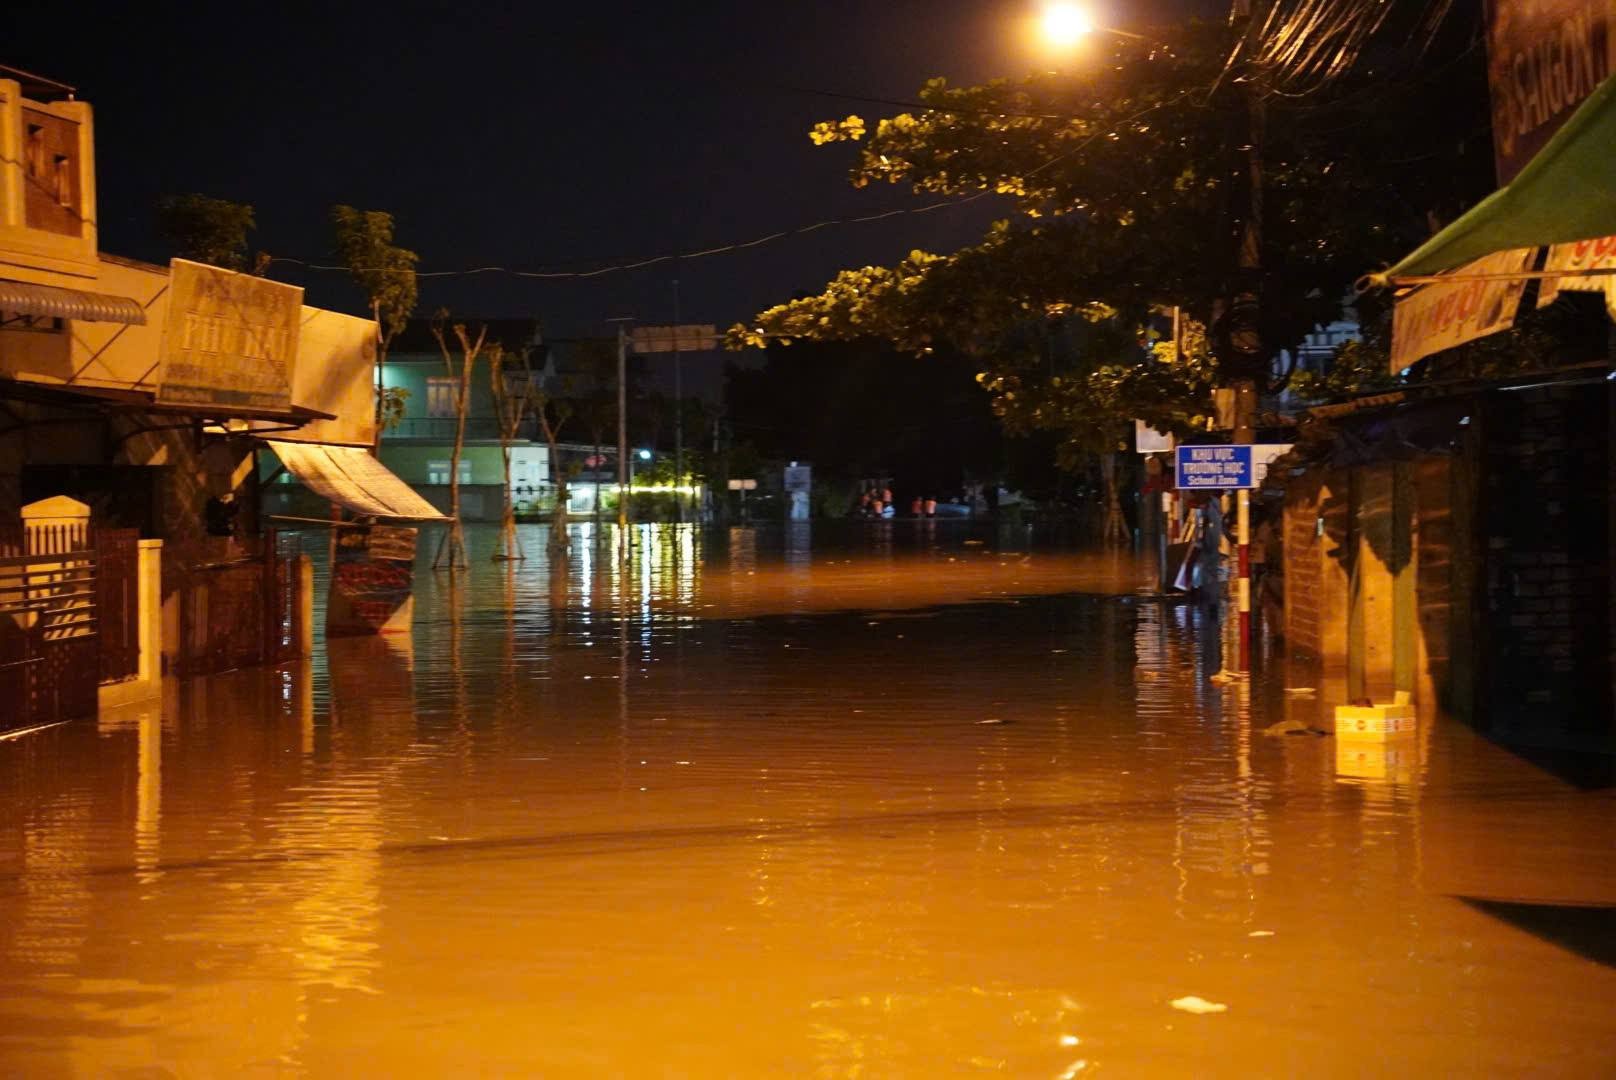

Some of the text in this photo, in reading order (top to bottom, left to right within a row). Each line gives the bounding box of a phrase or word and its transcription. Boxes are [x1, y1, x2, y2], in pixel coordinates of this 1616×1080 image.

[1191, 448, 1213, 461] KHU
[1188, 475, 1239, 486] School Zone
